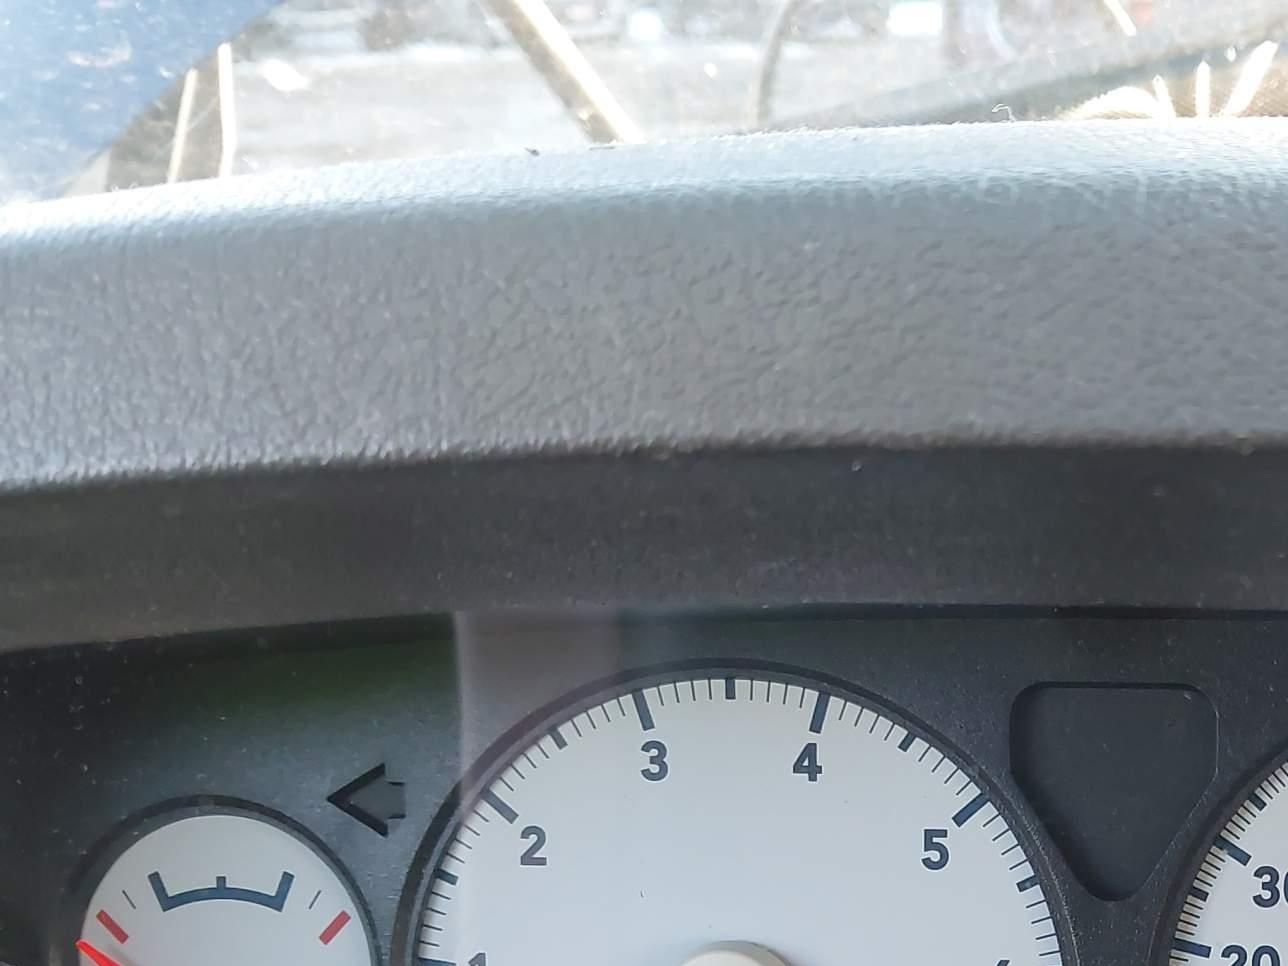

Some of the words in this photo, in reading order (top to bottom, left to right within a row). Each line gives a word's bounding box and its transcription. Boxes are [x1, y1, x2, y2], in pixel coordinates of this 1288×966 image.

[640, 741, 669, 782] 3
[792, 742, 823, 782] 4
[519, 825, 548, 867] 2
[921, 829, 949, 870] 5
